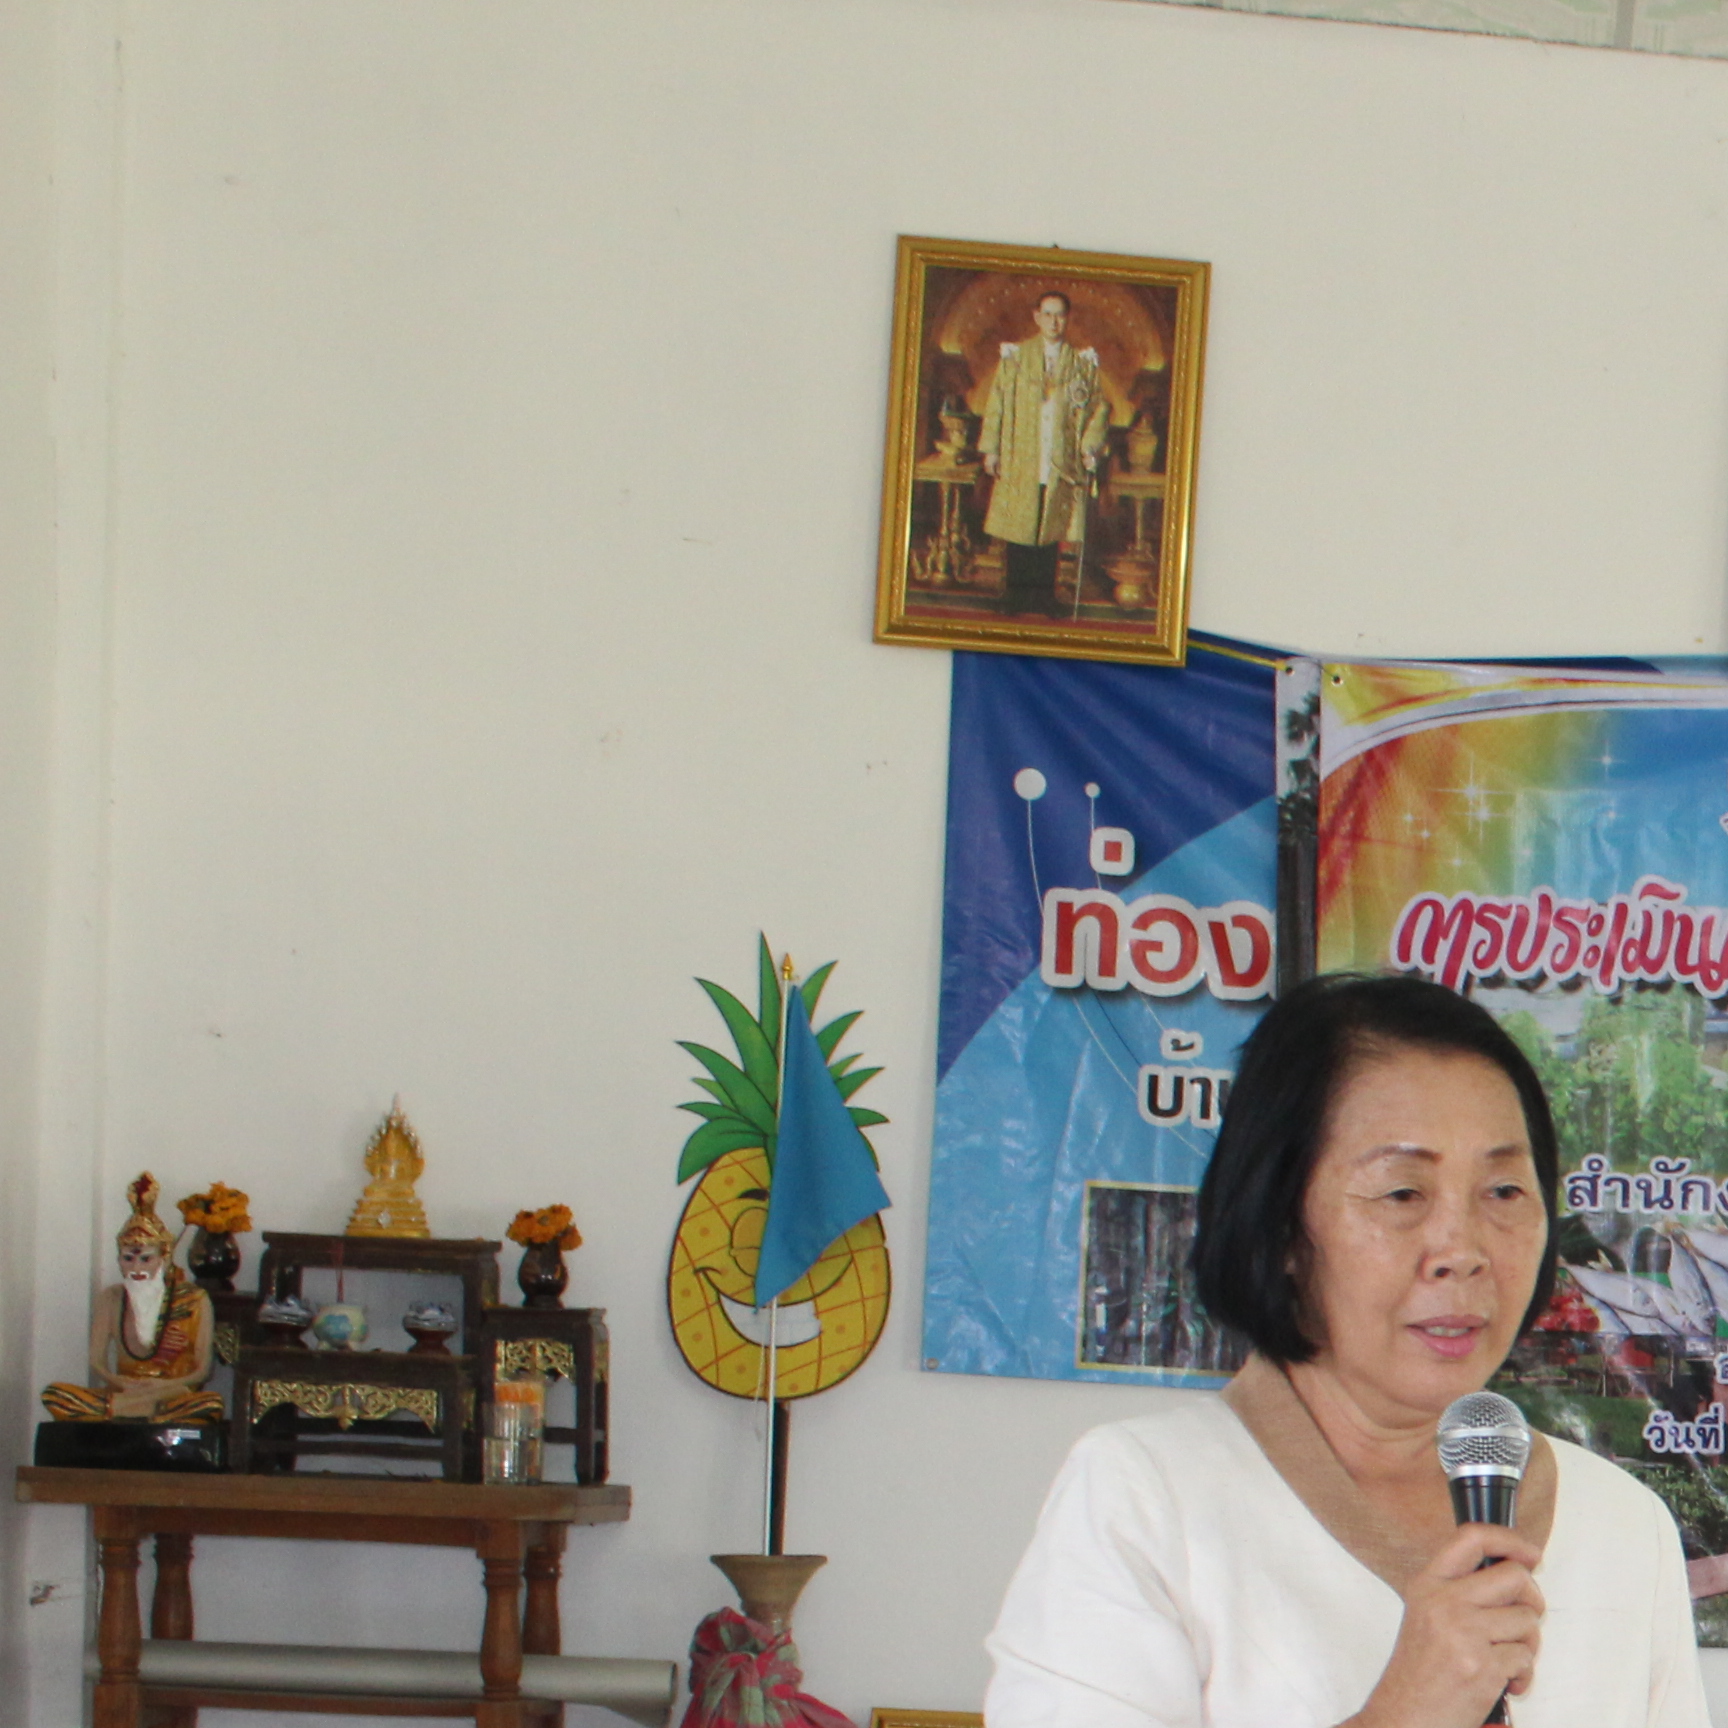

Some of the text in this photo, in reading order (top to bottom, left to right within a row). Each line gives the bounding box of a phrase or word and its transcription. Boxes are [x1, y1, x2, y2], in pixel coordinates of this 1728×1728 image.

[1054, 840, 1271, 988] ท่อง
[1647, 1407, 1720, 1450] วันที่
